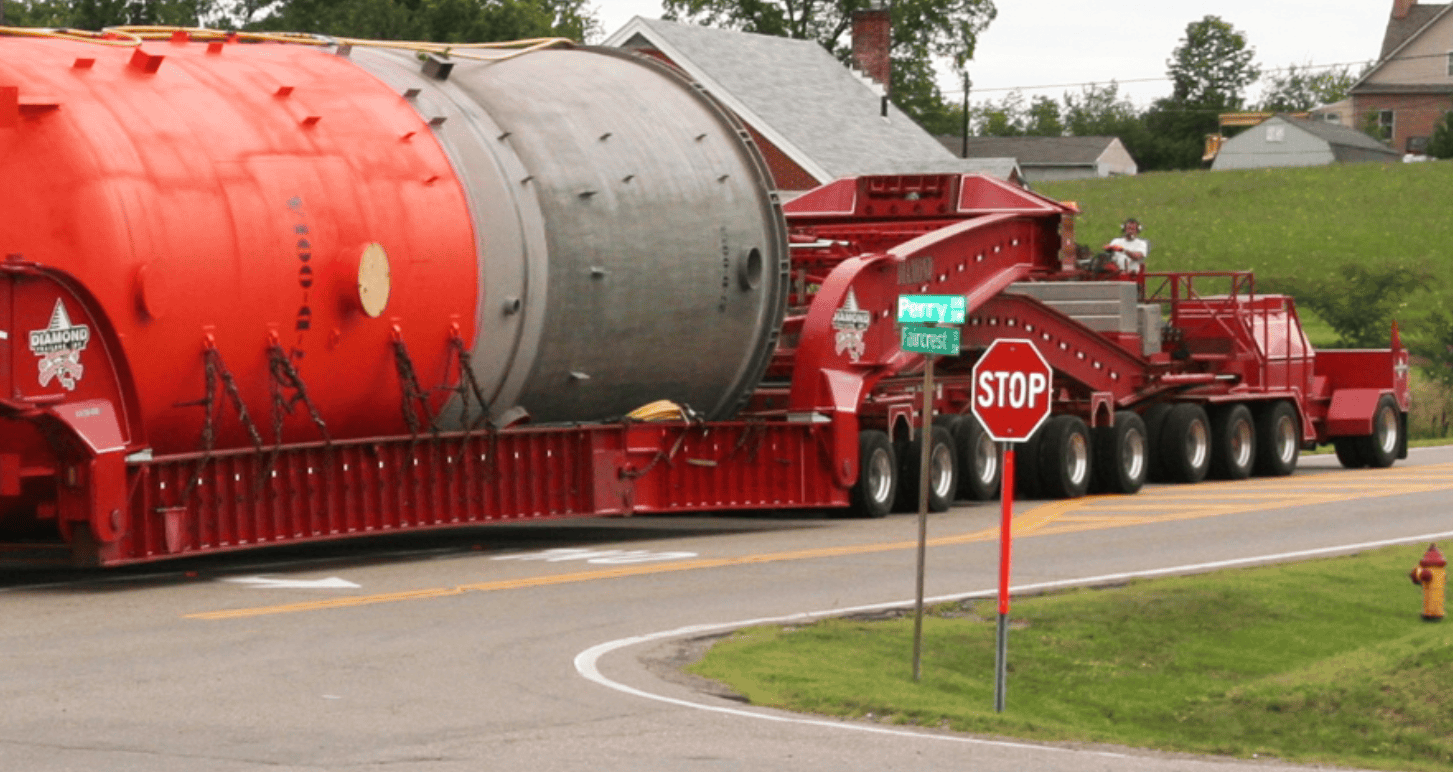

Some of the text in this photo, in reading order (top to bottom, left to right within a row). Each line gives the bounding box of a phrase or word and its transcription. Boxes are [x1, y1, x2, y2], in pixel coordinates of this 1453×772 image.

[898, 297, 948, 324] Perry
[31, 328, 88, 346] DIAMOND
[978, 371, 1046, 409] STOP
